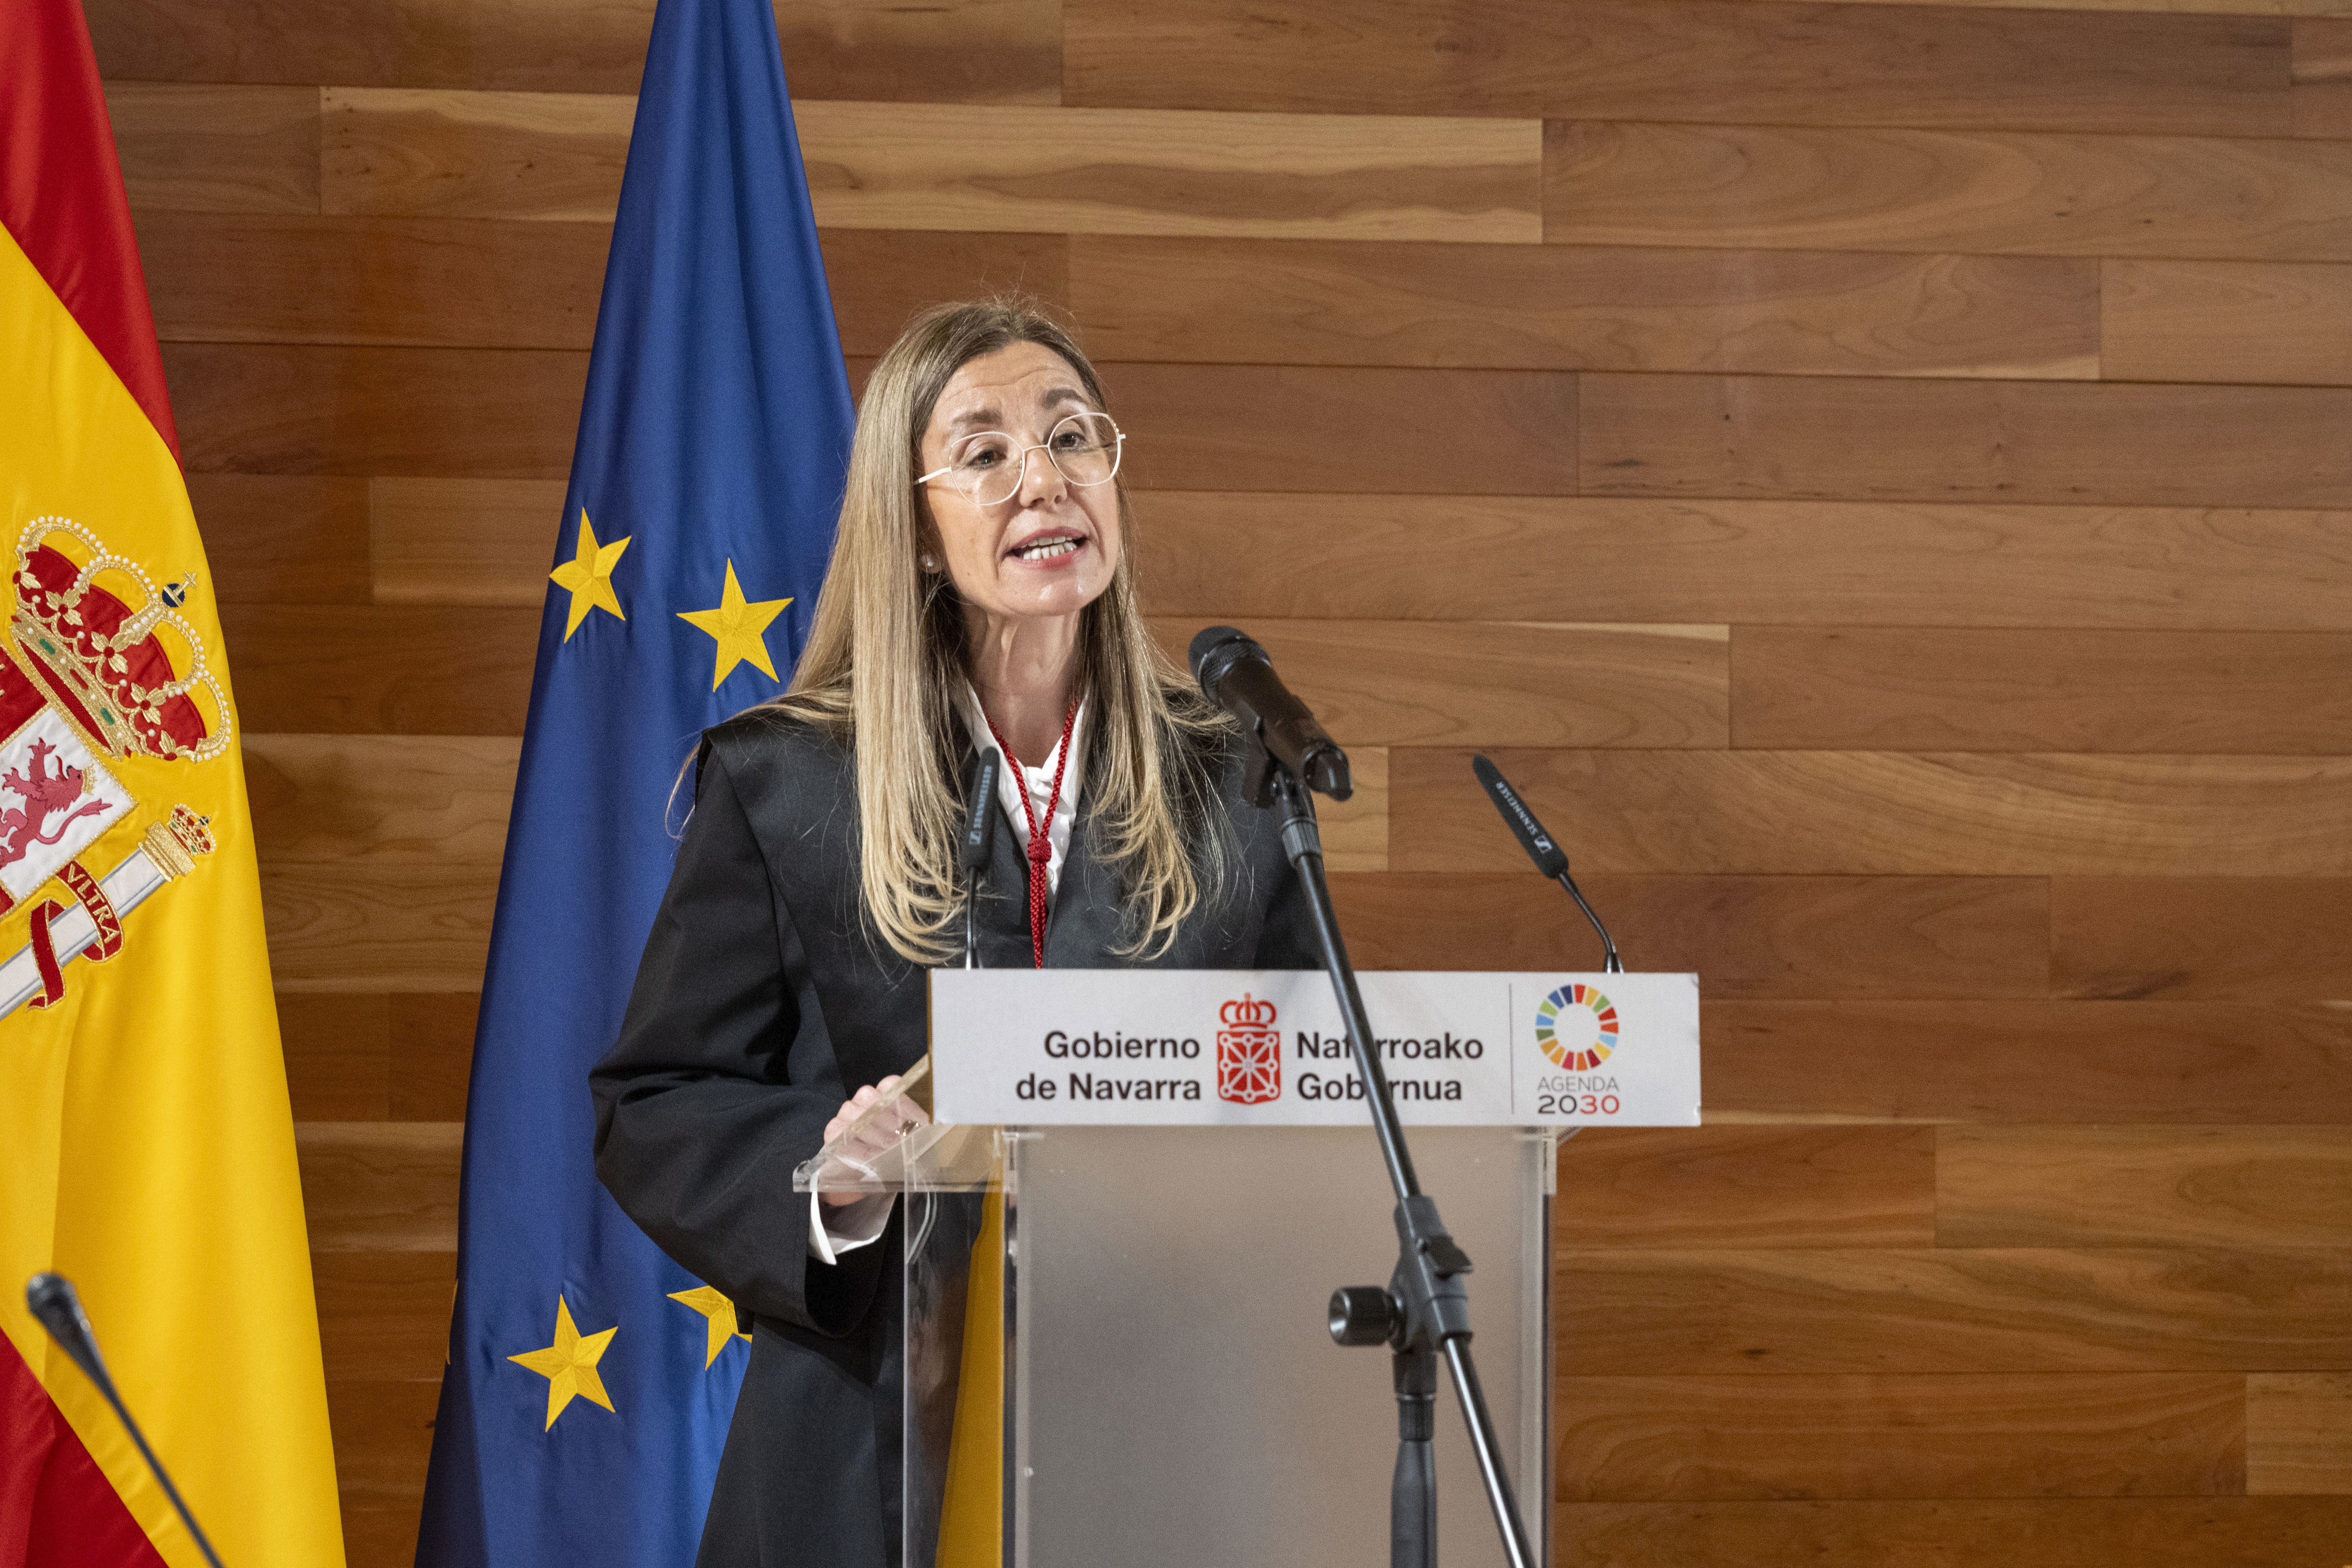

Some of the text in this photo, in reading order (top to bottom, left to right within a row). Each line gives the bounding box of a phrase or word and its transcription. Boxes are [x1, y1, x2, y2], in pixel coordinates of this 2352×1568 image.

[67, 863, 120, 944] VLTRA
[1044, 1031, 1200, 1059] Gobierno
[1297, 1031, 1483, 1059] Nafrroako
[1016, 1073, 1201, 1100] de Navarra
[1297, 1073, 1462, 1100] Gobrnua
[1537, 1076, 1619, 1092] AGENDA
[1537, 1094, 1620, 1115] 2030
